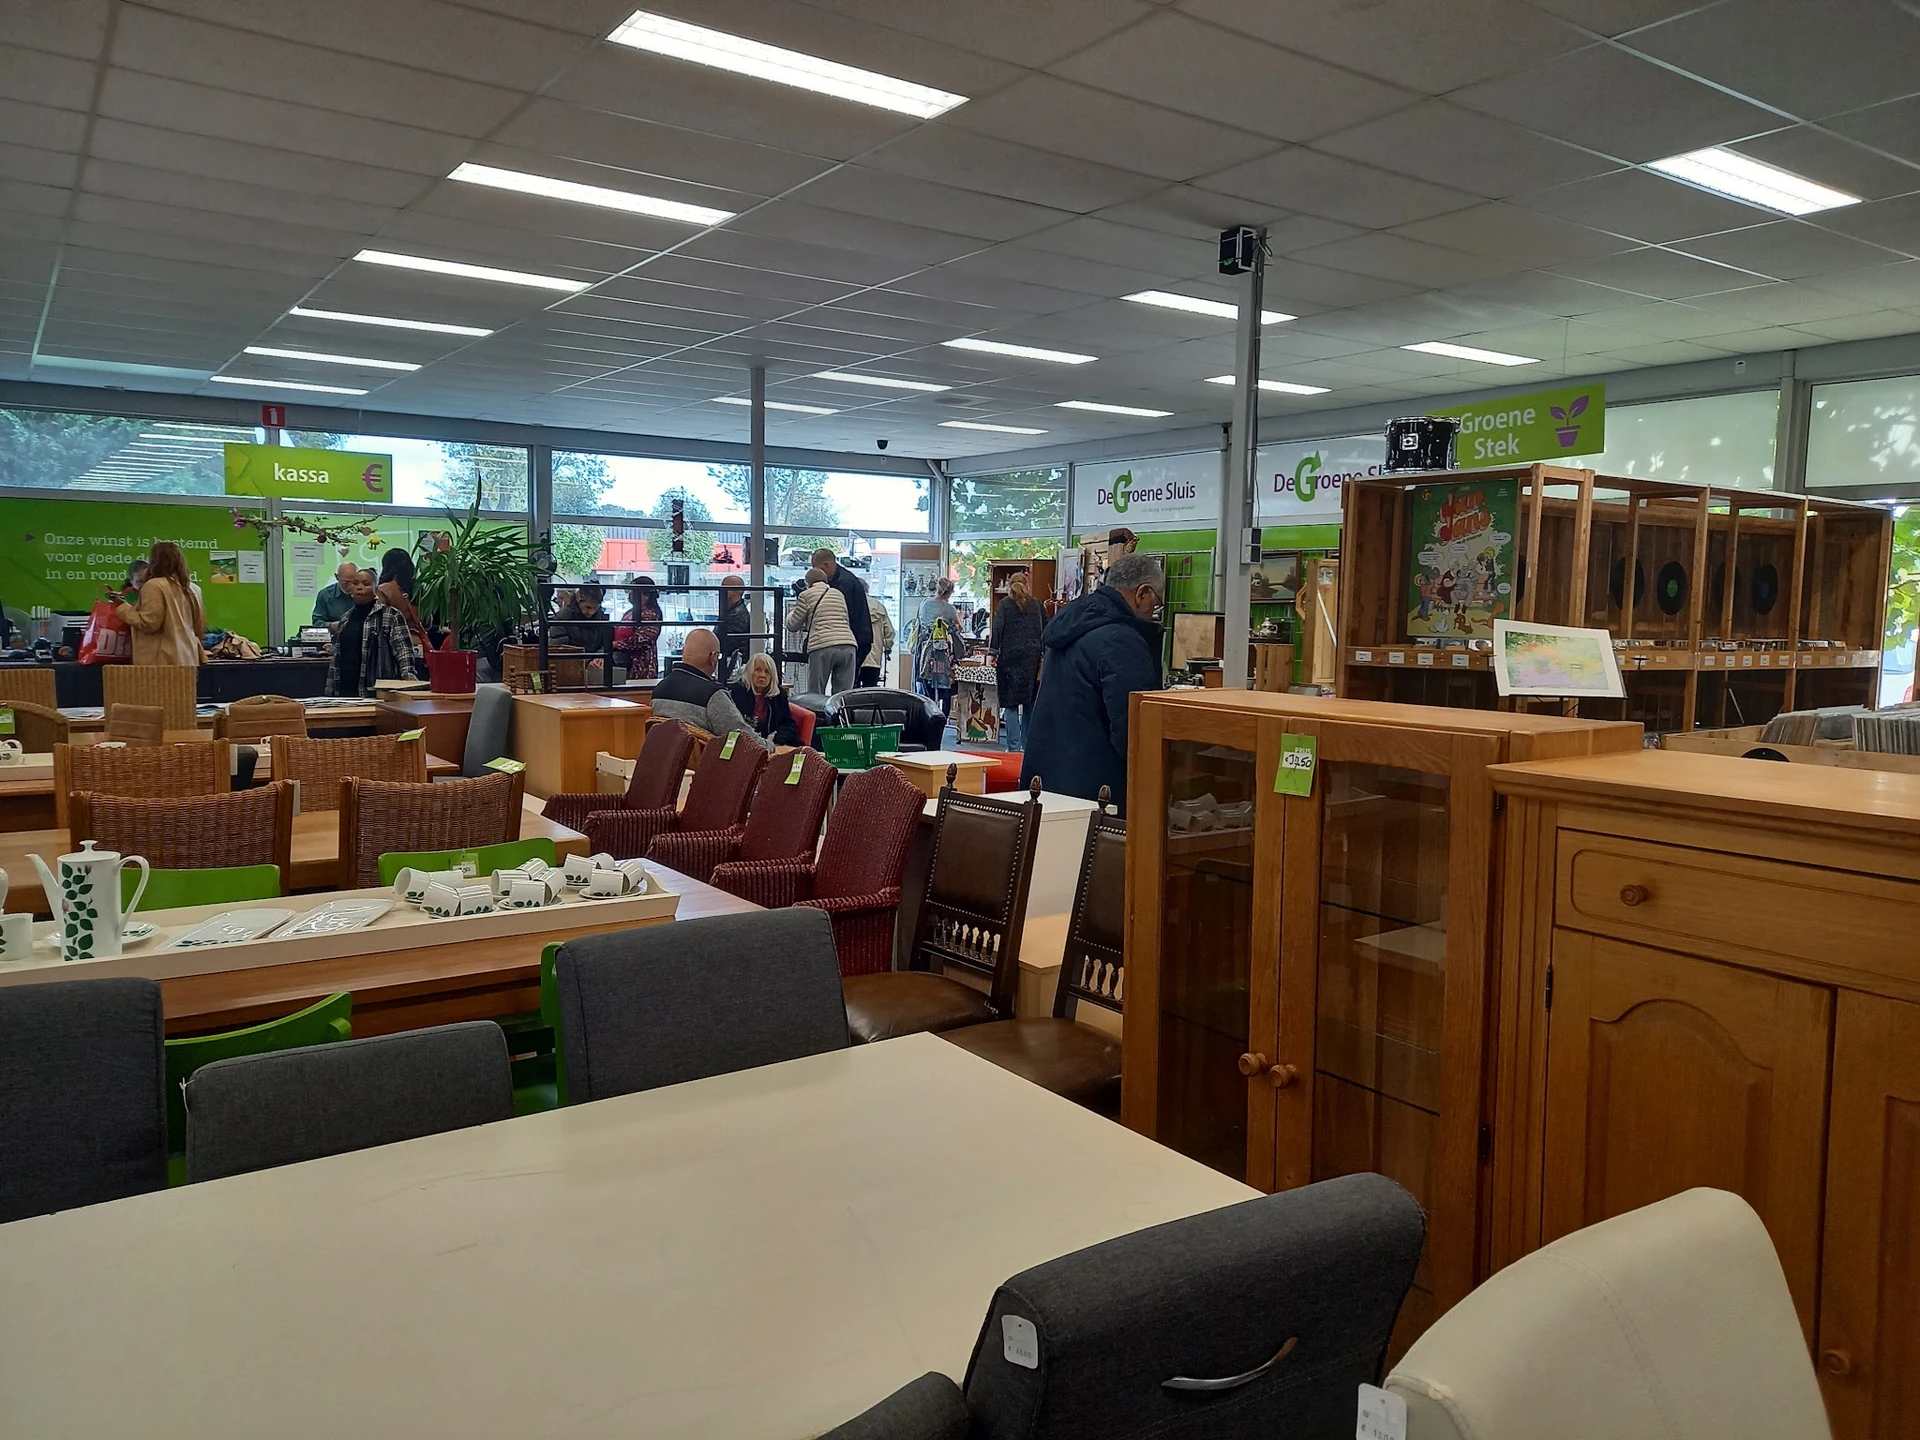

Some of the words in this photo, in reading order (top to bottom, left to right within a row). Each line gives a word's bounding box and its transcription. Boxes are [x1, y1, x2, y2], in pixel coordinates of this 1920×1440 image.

[1459, 407, 1536, 435] Groene
[1473, 433, 1520, 460] Stek
[273, 462, 330, 484] kassa
[1165, 481, 1196, 501] Sluis
[44, 532, 85, 546] Onze
[88, 535, 134, 547] winst
[136, 536, 150, 548] is
[153, 537, 218, 549] bstemd
[45, 552, 83, 563] voor
[86, 552, 132, 566] goede
[45, 568, 62, 580] in
[66, 570, 86, 580] en
